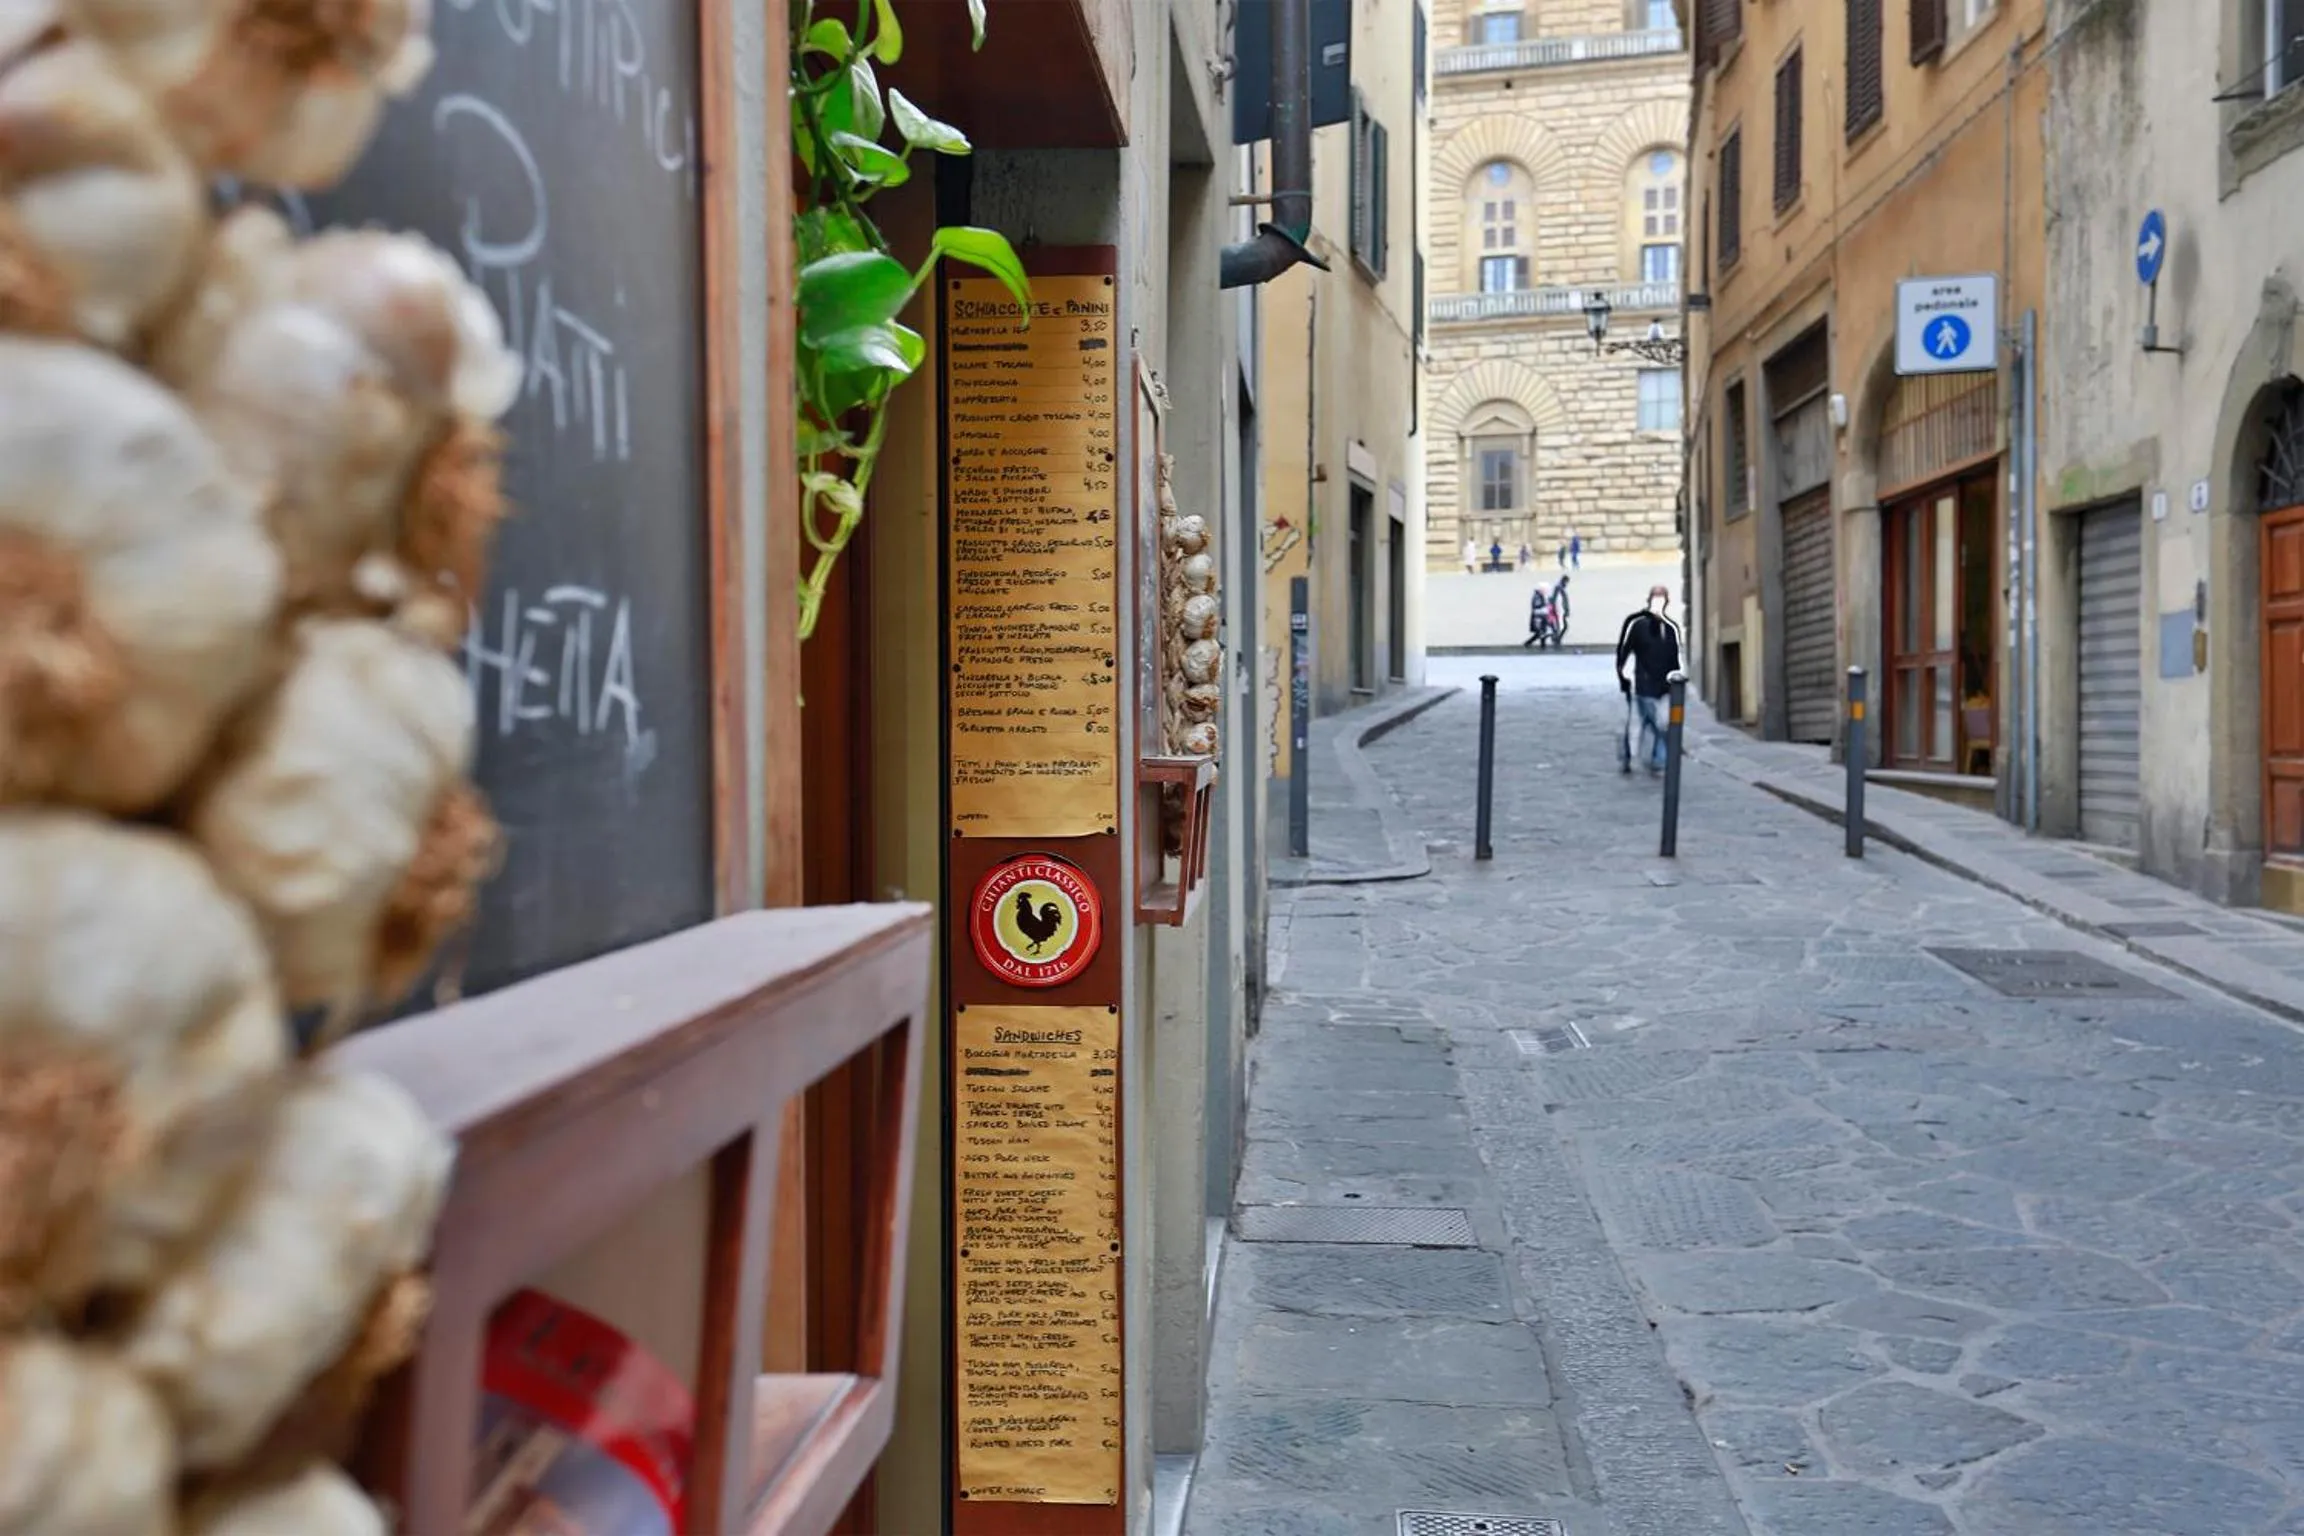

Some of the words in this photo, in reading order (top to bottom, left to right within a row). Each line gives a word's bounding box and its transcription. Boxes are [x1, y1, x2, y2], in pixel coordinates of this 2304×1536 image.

[1066, 298, 1110, 314] PANINI
[982, 866, 1030, 912] CHIANTI
[1034, 866, 1090, 913] CLASSICO
[1002, 958, 1032, 976] DAL
[1039, 961, 1070, 977] 1716
[994, 1027, 1083, 1043] SANDWICHES
